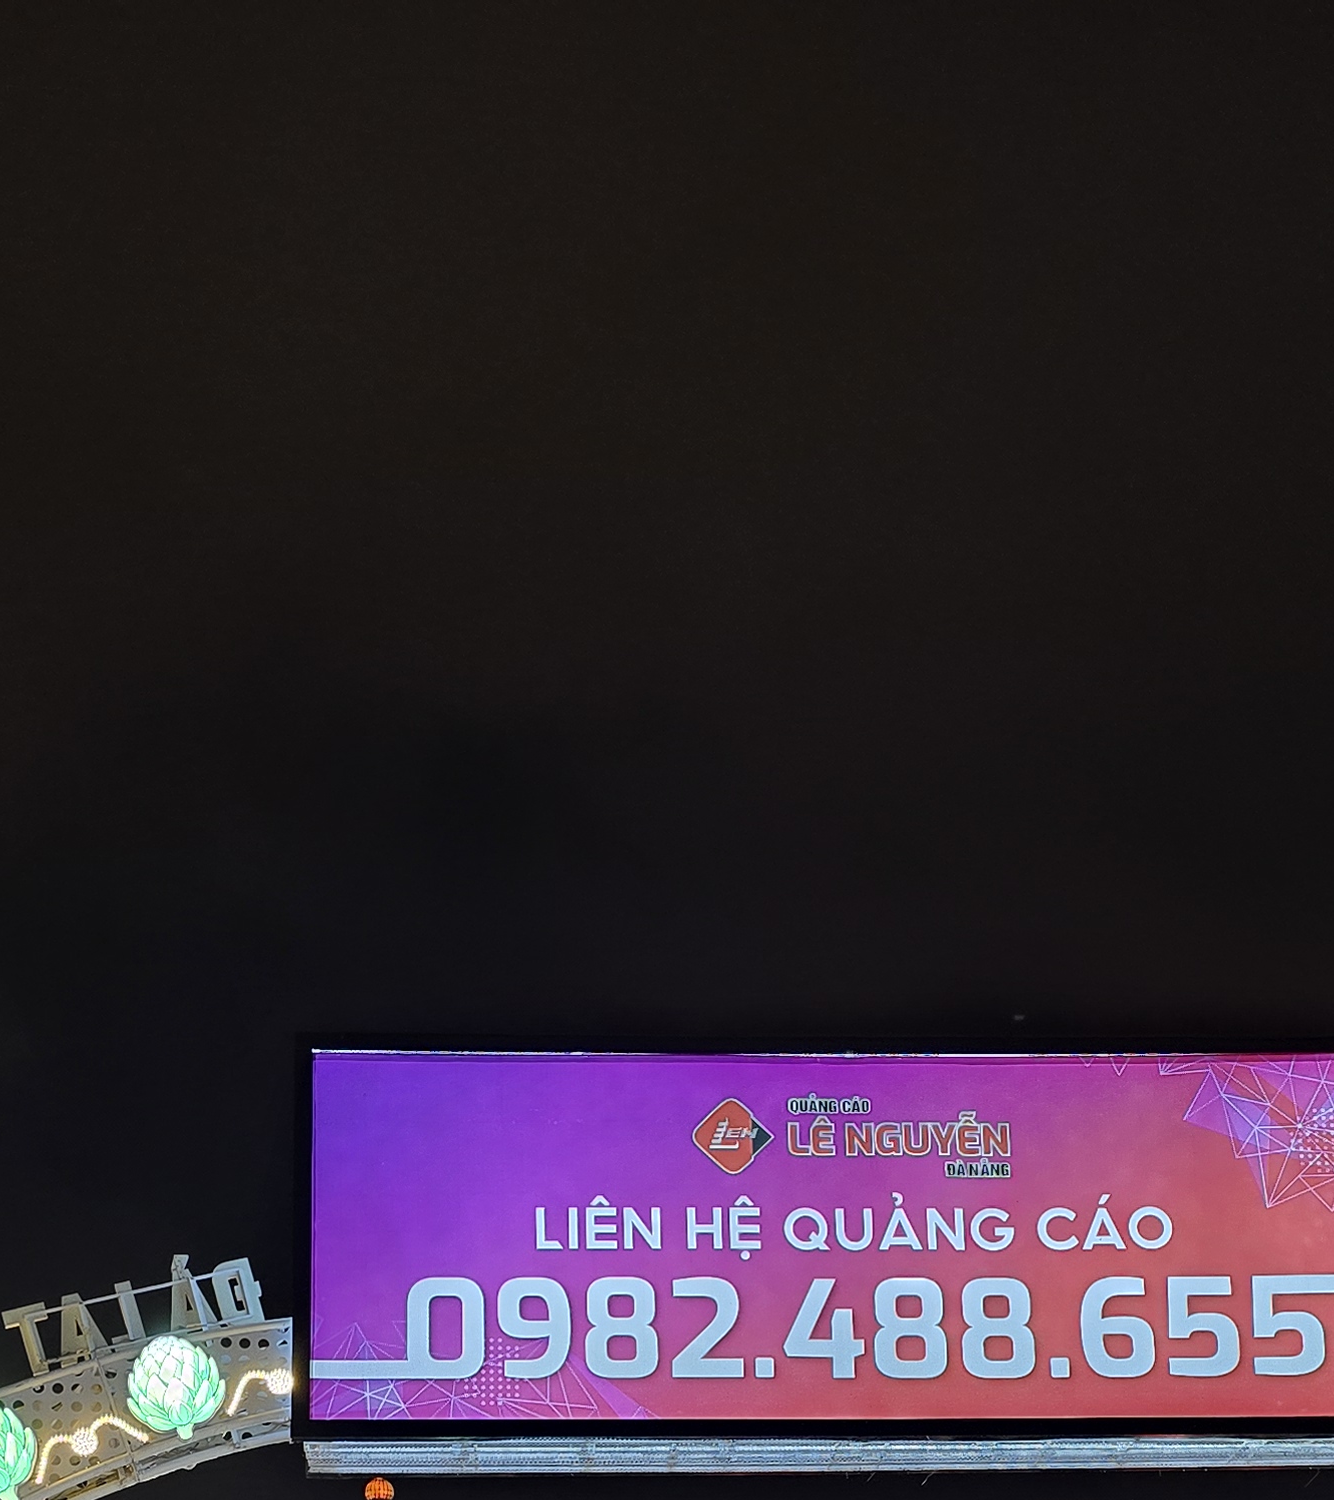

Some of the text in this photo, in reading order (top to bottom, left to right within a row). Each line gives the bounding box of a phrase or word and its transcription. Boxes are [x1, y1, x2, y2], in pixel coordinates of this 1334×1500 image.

[788, 1093, 871, 1114] QUẢNG CÁO
[787, 1111, 1012, 1157] LÊ NGUYỄN
[945, 1159, 968, 1178] ĐÀ
[534, 1193, 1174, 1260] LIÊN HỆ QUẢNG CÁO
[405, 1274, 1327, 1381] 0982.488.655
